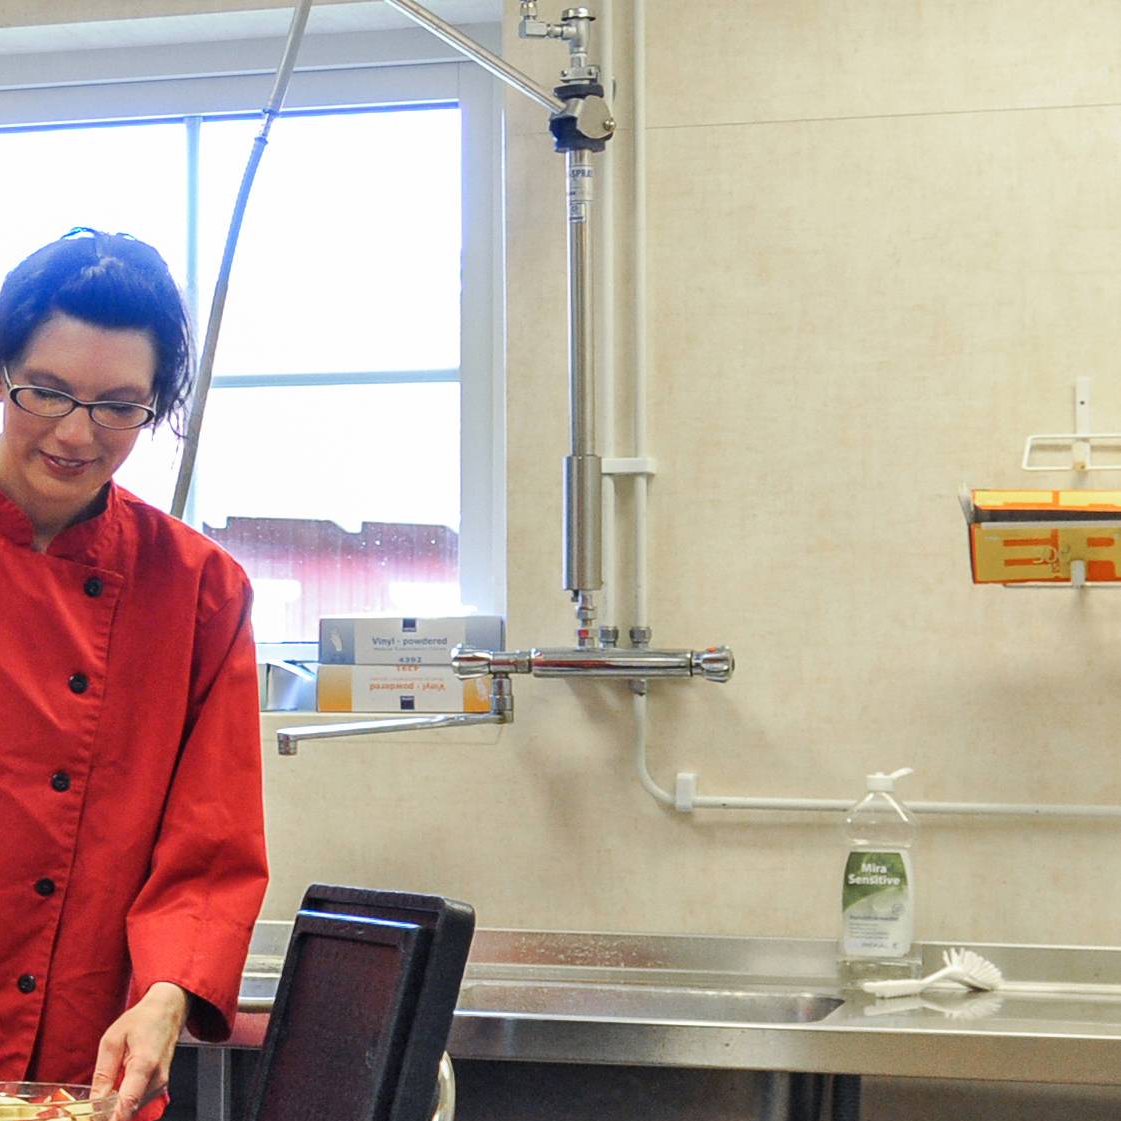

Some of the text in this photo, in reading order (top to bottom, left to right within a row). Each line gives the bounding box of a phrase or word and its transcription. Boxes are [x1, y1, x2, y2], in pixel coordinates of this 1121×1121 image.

[372, 637, 395, 646] Vinyl
[402, 637, 447, 646] powdered
[862, 863, 887, 873] Mira
[848, 874, 900, 885] Sensitive
